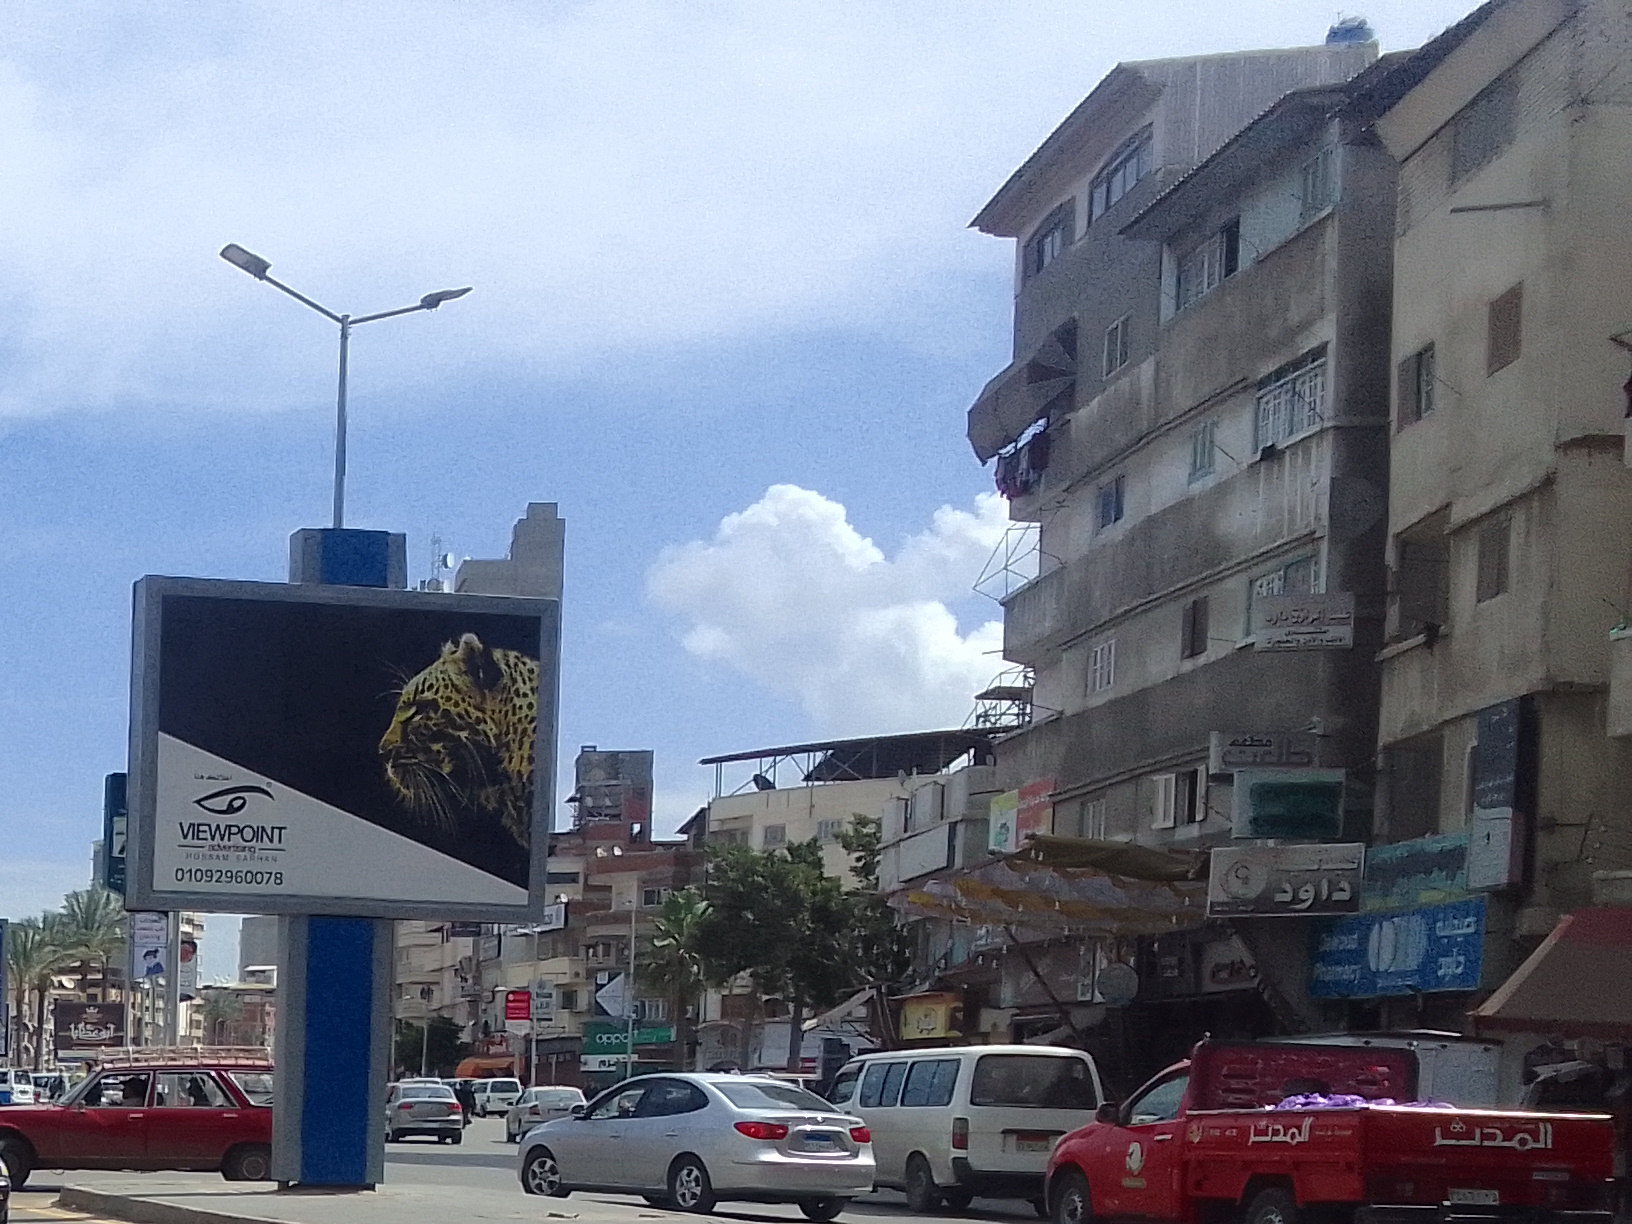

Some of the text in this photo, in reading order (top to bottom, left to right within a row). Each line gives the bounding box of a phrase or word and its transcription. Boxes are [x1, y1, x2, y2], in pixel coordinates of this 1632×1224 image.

[1228, 736, 1273, 747] مطعم
[179, 822, 287, 844] VIEWPOINT
[208, 844, 256, 855] advertising
[175, 868, 284, 886] 01092960078
[1273, 876, 1352, 910] داود
[595, 1032, 630, 1044] oppo
